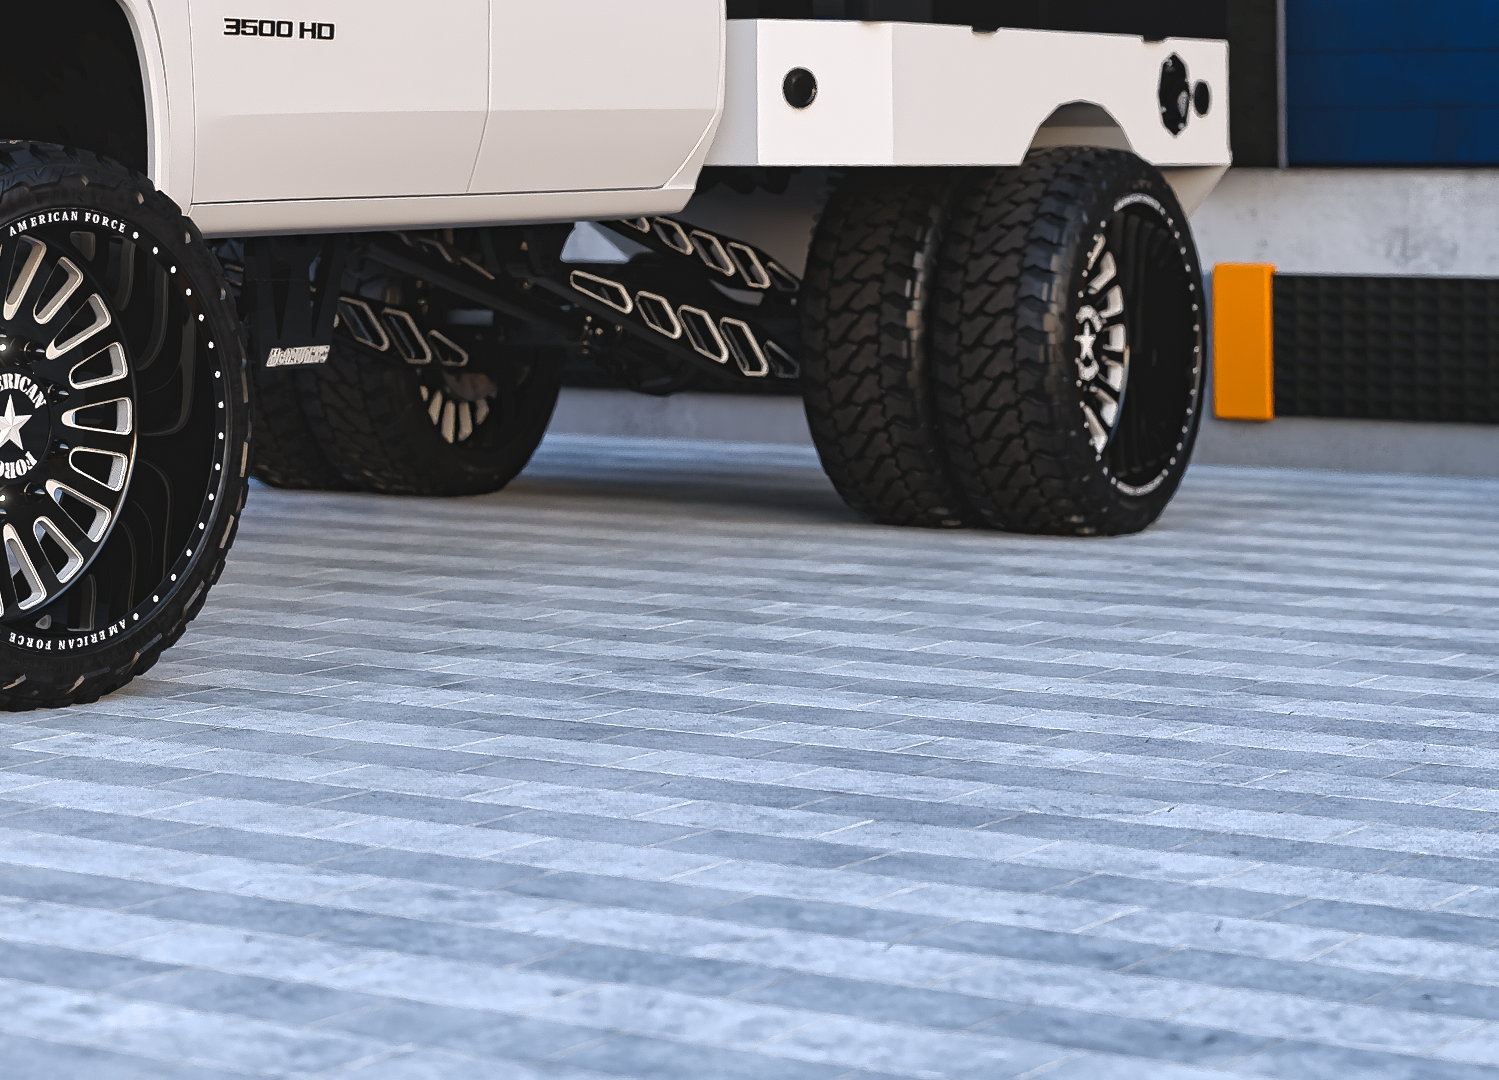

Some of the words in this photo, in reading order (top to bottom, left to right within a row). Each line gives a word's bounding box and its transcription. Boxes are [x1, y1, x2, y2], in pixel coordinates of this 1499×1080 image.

[223, 17, 294, 38] 3500
[299, 21, 335, 40] HD
[9, 210, 79, 237] AMERICAN
[84, 211, 127, 234] FORCE
[8, 631, 52, 651] FORCE
[57, 618, 127, 651] AMERICAN
